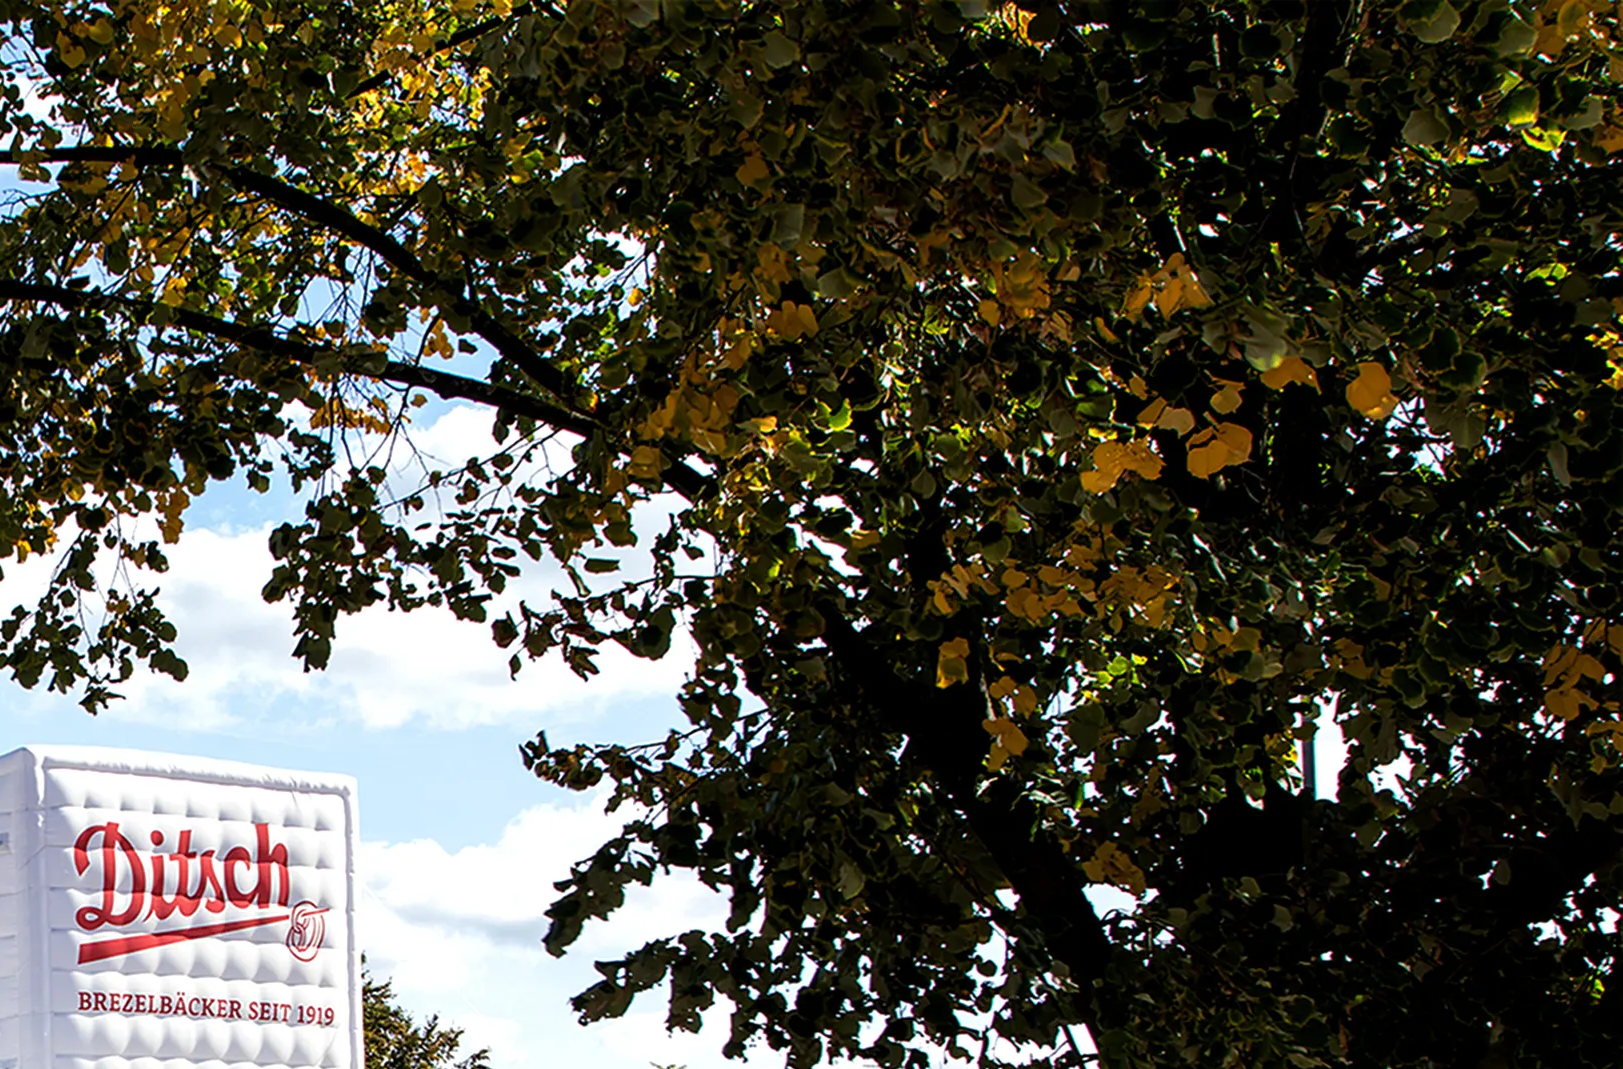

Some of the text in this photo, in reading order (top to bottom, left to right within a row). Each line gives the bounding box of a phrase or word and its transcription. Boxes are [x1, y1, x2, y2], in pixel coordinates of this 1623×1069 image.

[73, 821, 290, 931] Ditsch
[78, 992, 335, 1026] BREZELBÄCKER SEIT 1919
